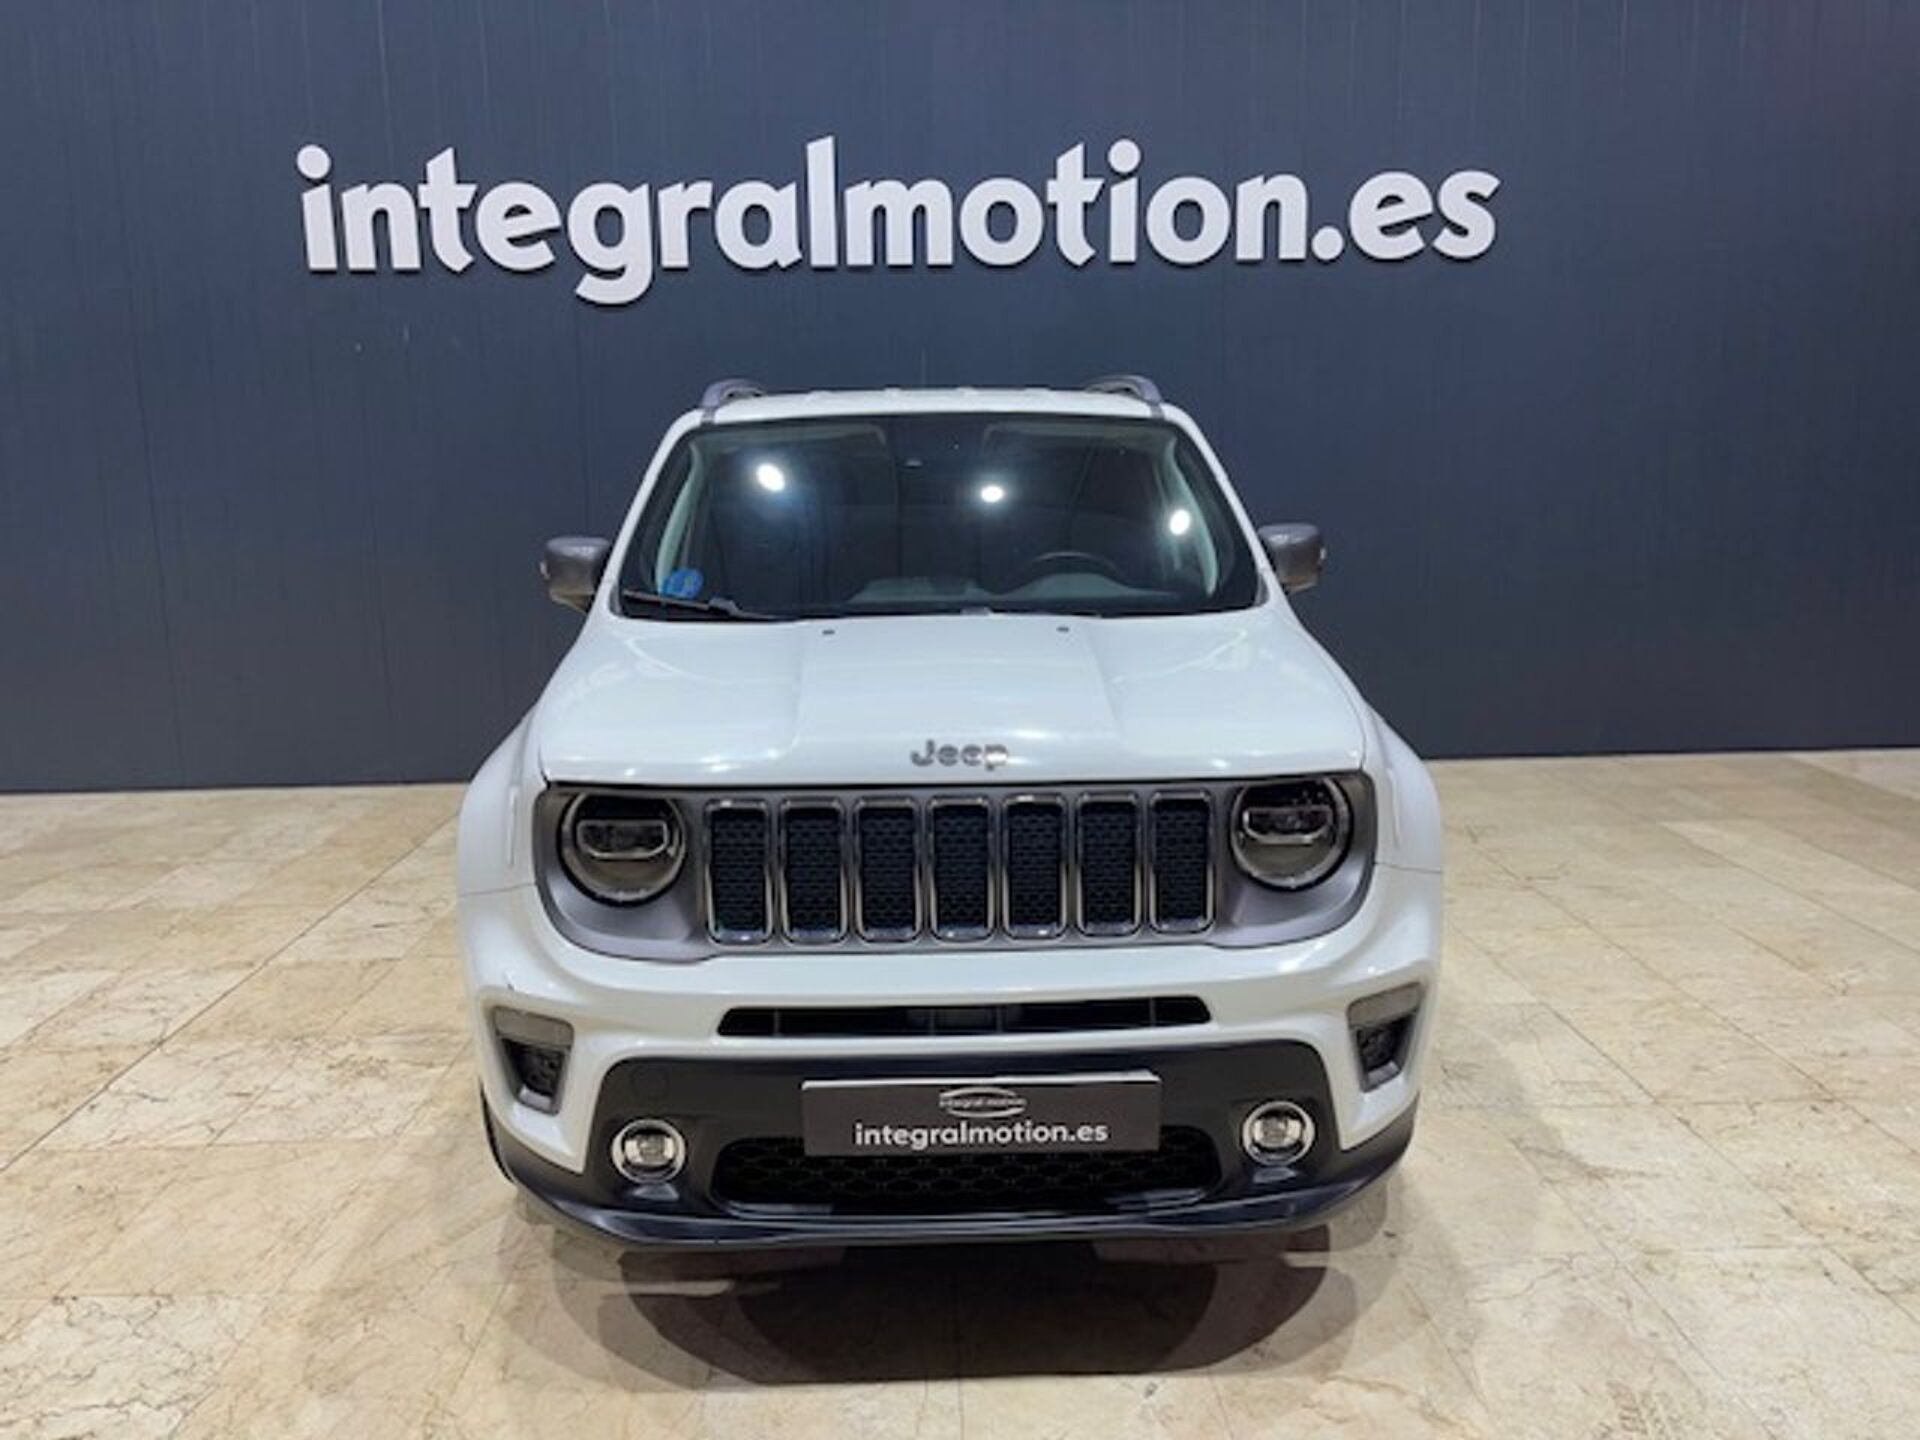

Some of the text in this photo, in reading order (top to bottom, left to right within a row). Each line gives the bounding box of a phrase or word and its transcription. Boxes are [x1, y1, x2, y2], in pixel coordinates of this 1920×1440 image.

[296, 135, 1500, 304] integralmotion.es
[910, 739, 1009, 771] Jeep
[854, 1119, 1109, 1151] integralmotion.es
